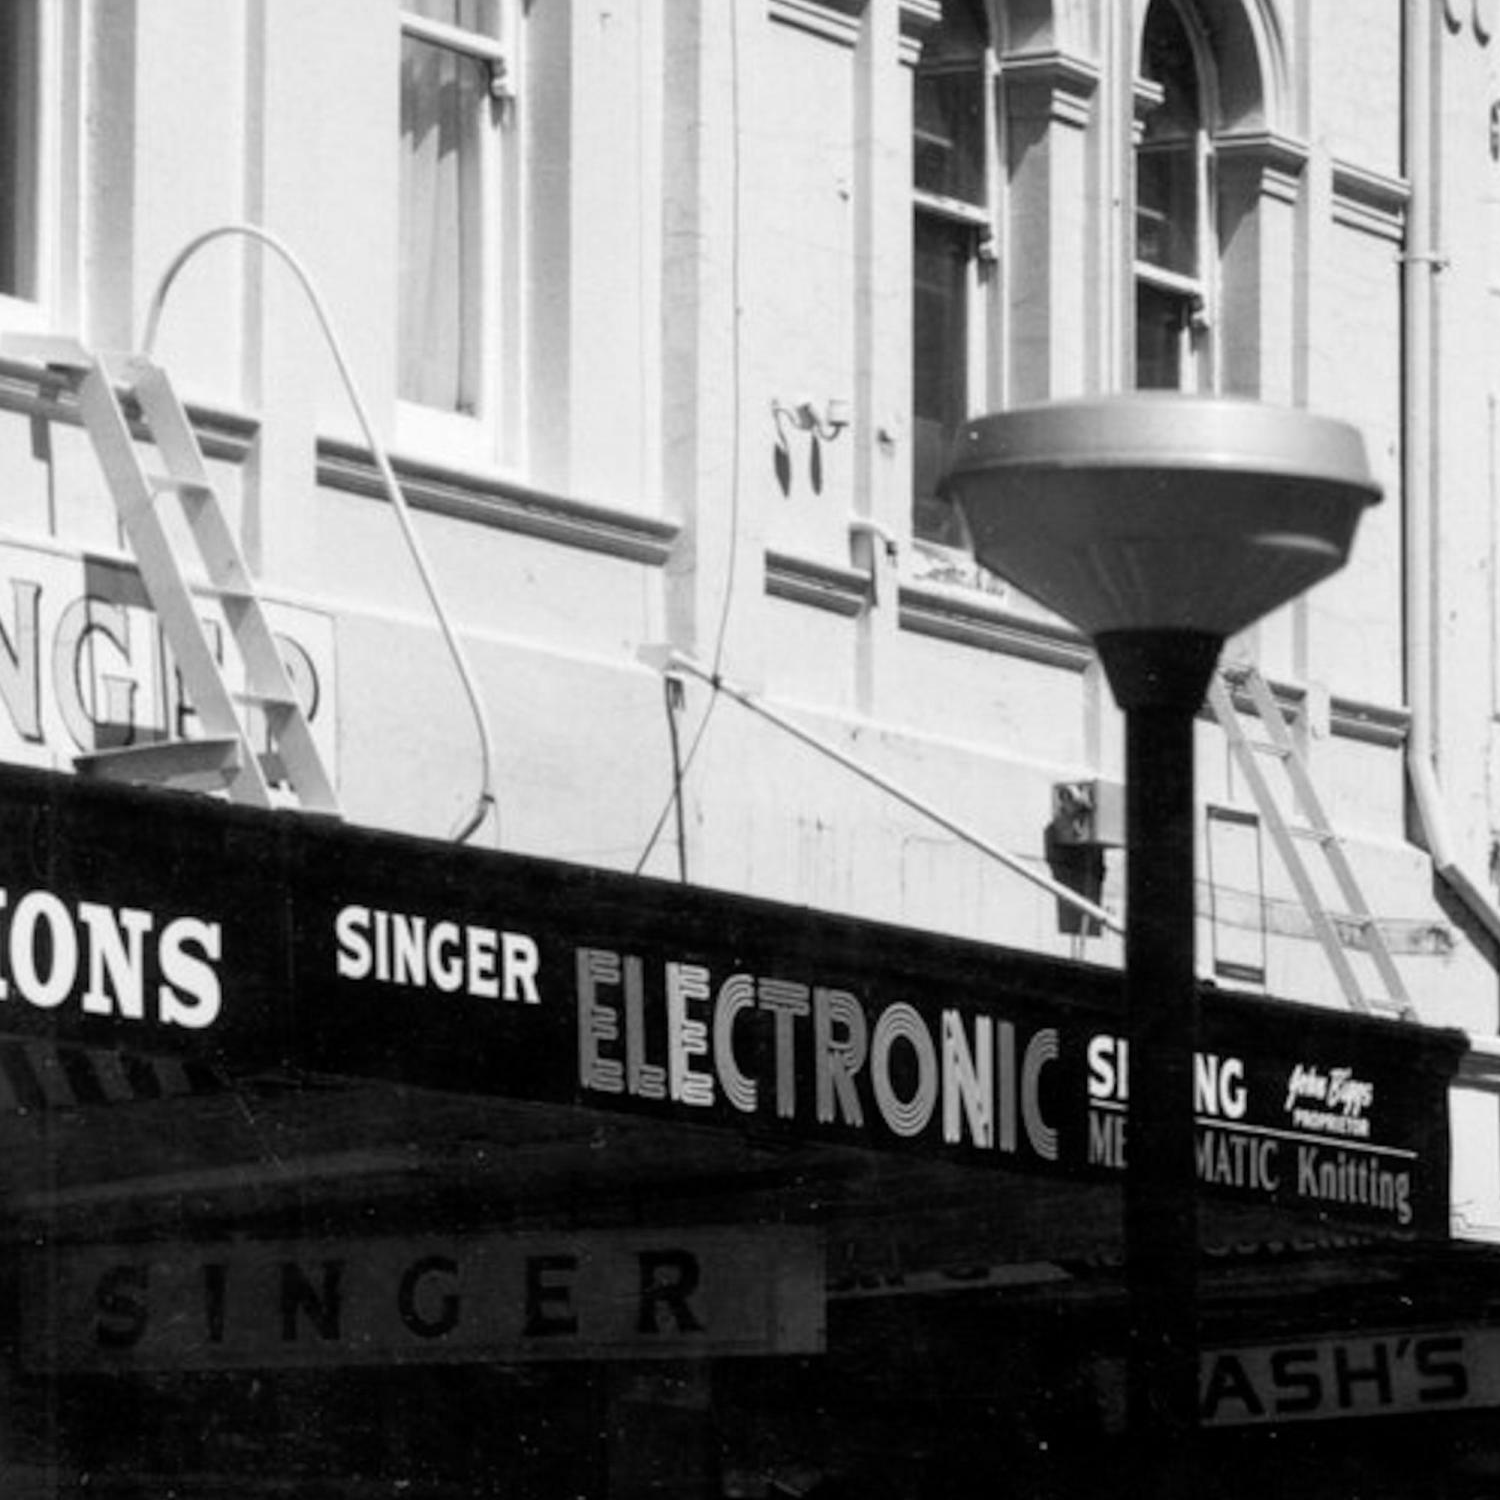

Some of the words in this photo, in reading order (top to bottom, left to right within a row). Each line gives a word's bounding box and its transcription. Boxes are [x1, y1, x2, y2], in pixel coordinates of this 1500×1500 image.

[0, 889, 222, 1029] ONS
[335, 904, 541, 1003] SINGER
[576, 947, 1059, 1161] ELECTRONIC
[1298, 1146, 1413, 1225] Knitting
[95, 1250, 706, 1348] SINGER
[1198, 1336, 1470, 1420] ASH'S
